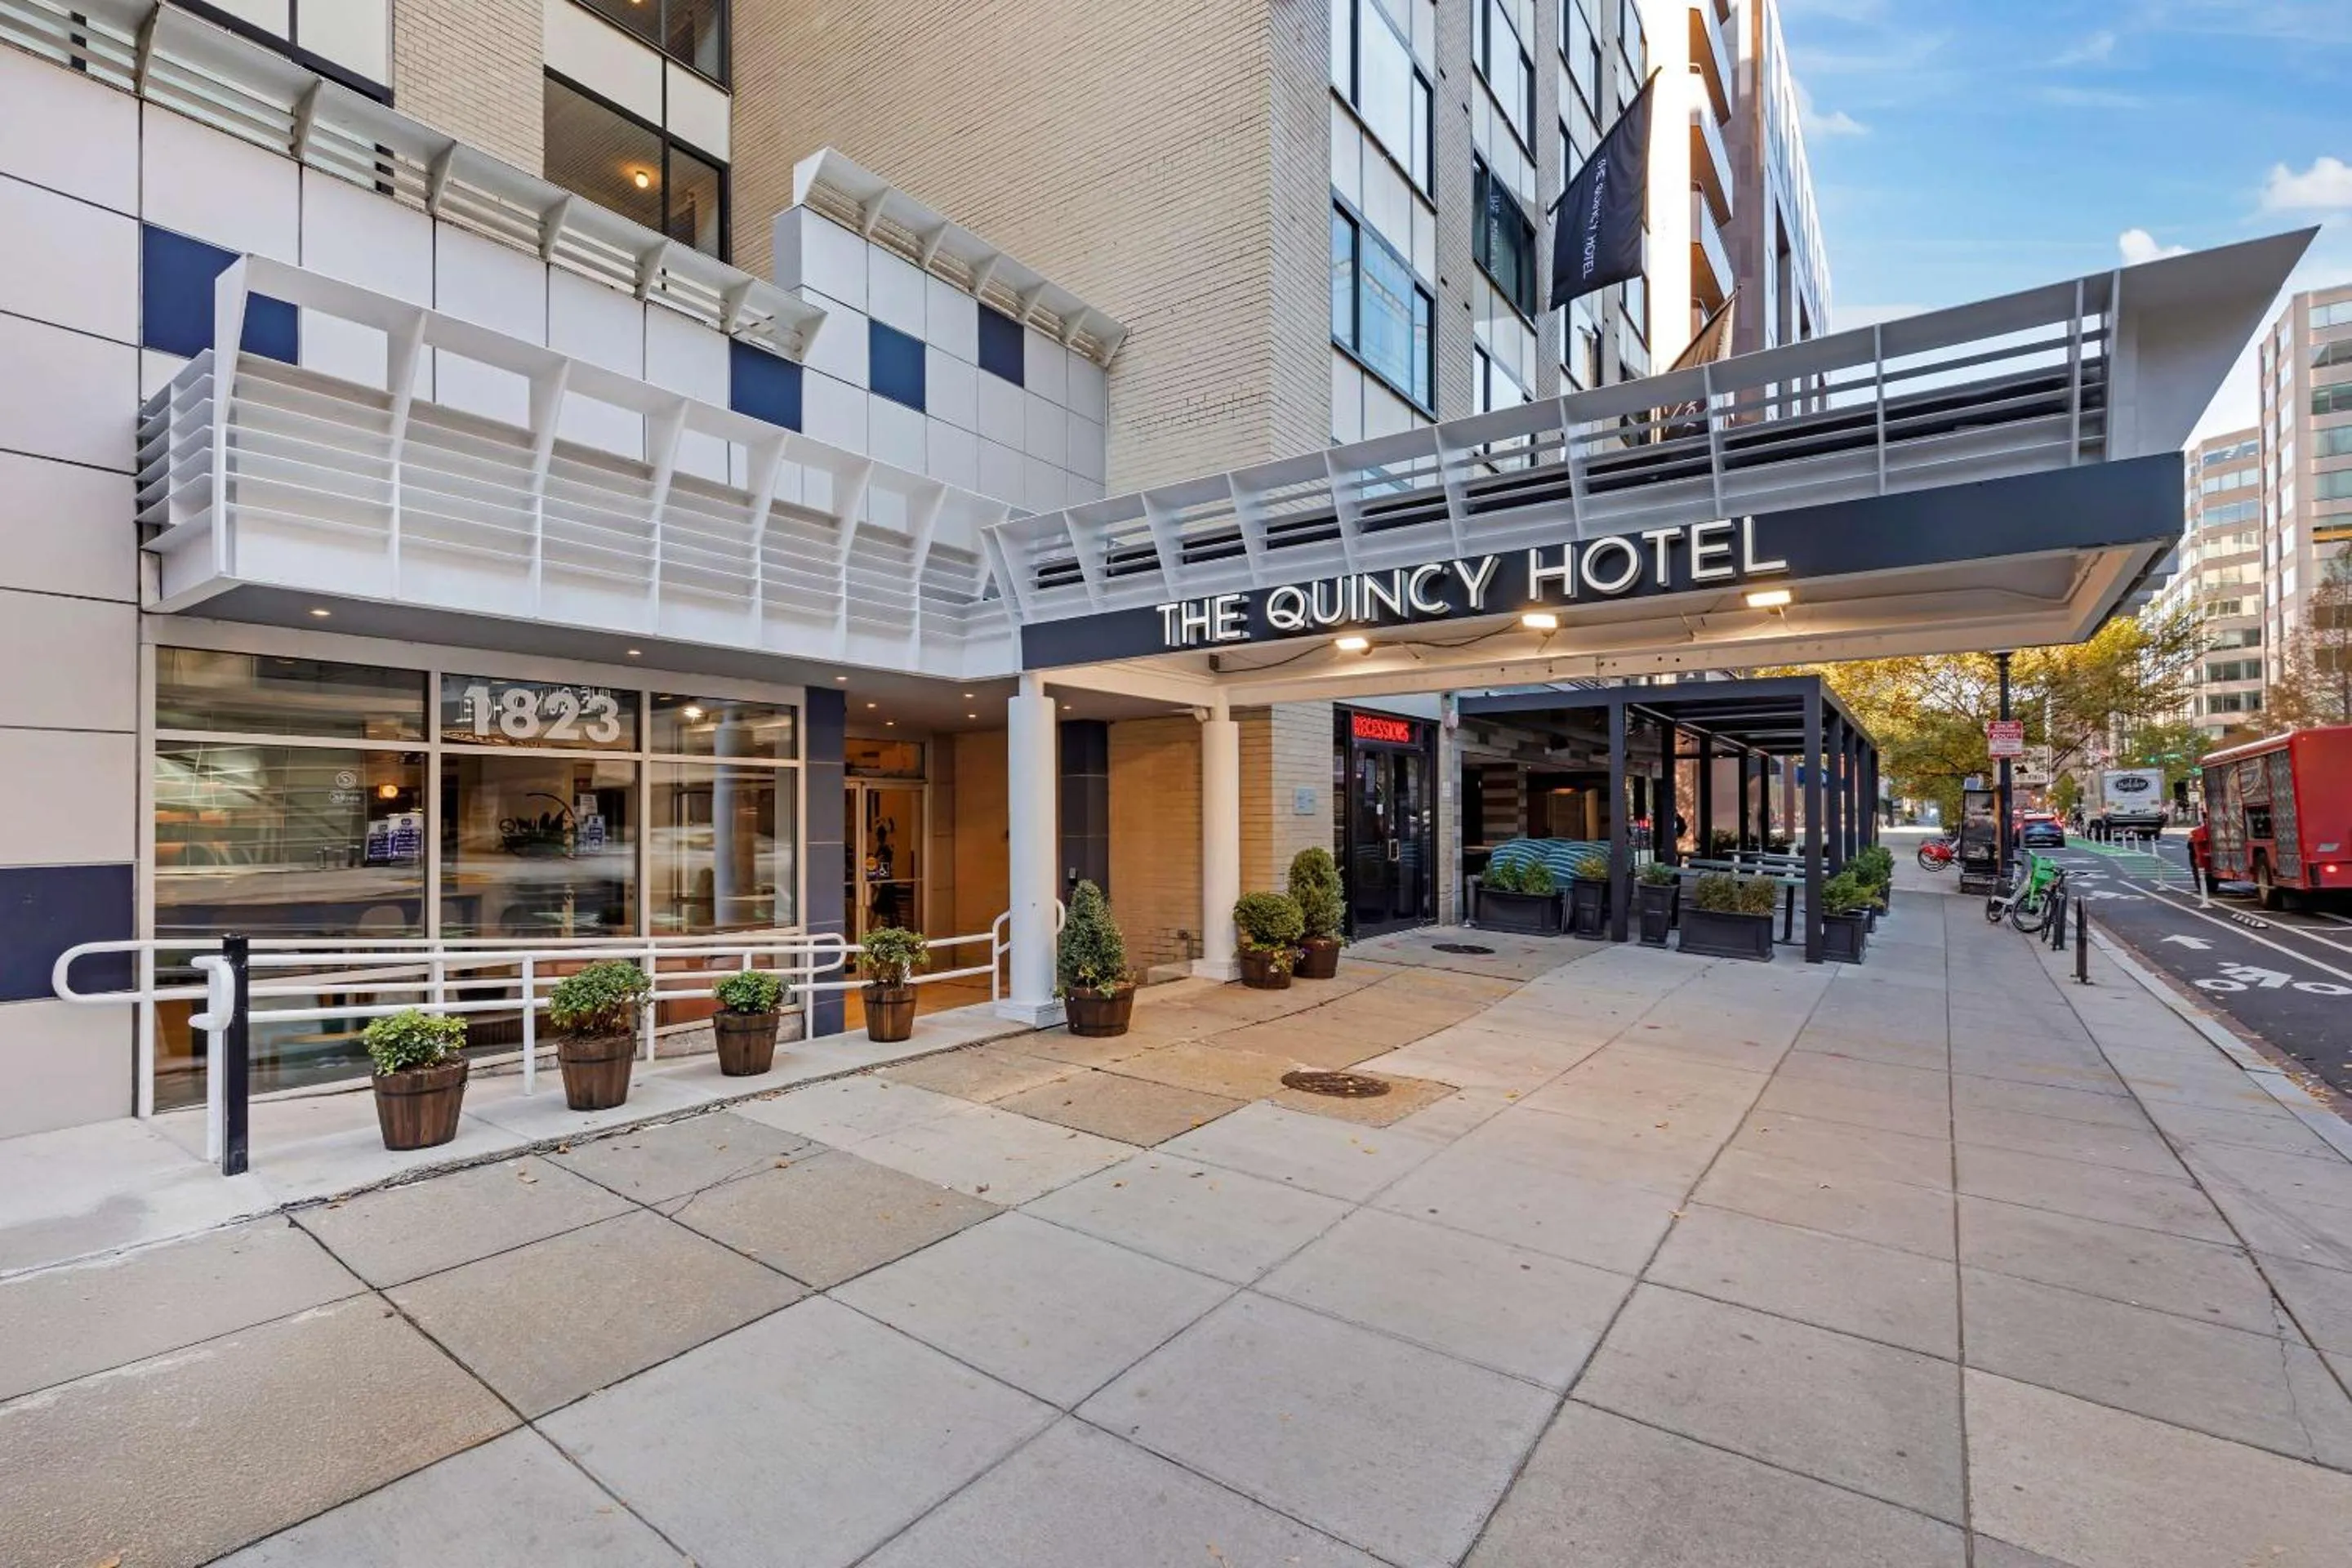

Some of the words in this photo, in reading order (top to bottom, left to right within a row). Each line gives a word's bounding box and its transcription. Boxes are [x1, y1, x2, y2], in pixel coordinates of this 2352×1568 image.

[1583, 234, 1597, 281] HOTEL
[1156, 594, 1250, 646] THE
[1267, 555, 1499, 630] QUINCY
[1529, 515, 1788, 601] HOTEL
[464, 686, 621, 742] 1823
